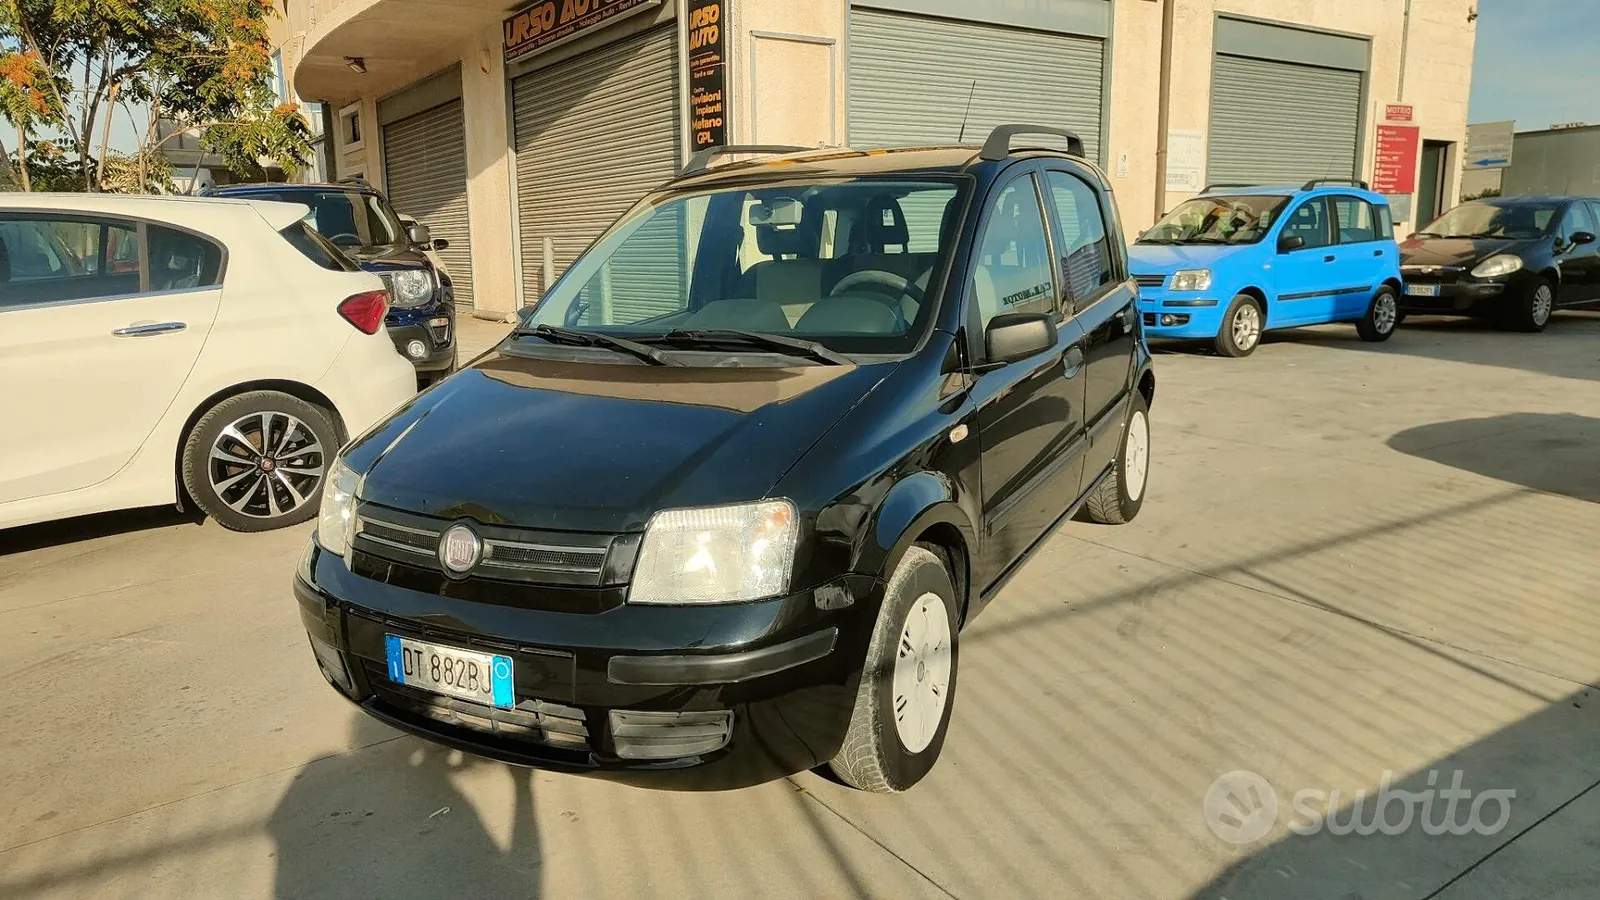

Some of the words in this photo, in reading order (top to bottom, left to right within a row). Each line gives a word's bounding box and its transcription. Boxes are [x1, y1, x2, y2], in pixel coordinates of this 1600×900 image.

[506, 2, 555, 46] URSO
[560, 0, 613, 23] AU
[579, 15, 600, 29] Noleggio
[602, 8, 615, 18] Auto
[690, 4, 719, 30] URSO
[690, 24, 719, 50] AUTO
[696, 103, 721, 118] Impianti
[692, 117, 722, 130] Metano
[697, 131, 714, 144] GPL
[450, 538, 473, 561] FIAT
[403, 647, 423, 678] DT
[431, 653, 491, 694] 882BJ
